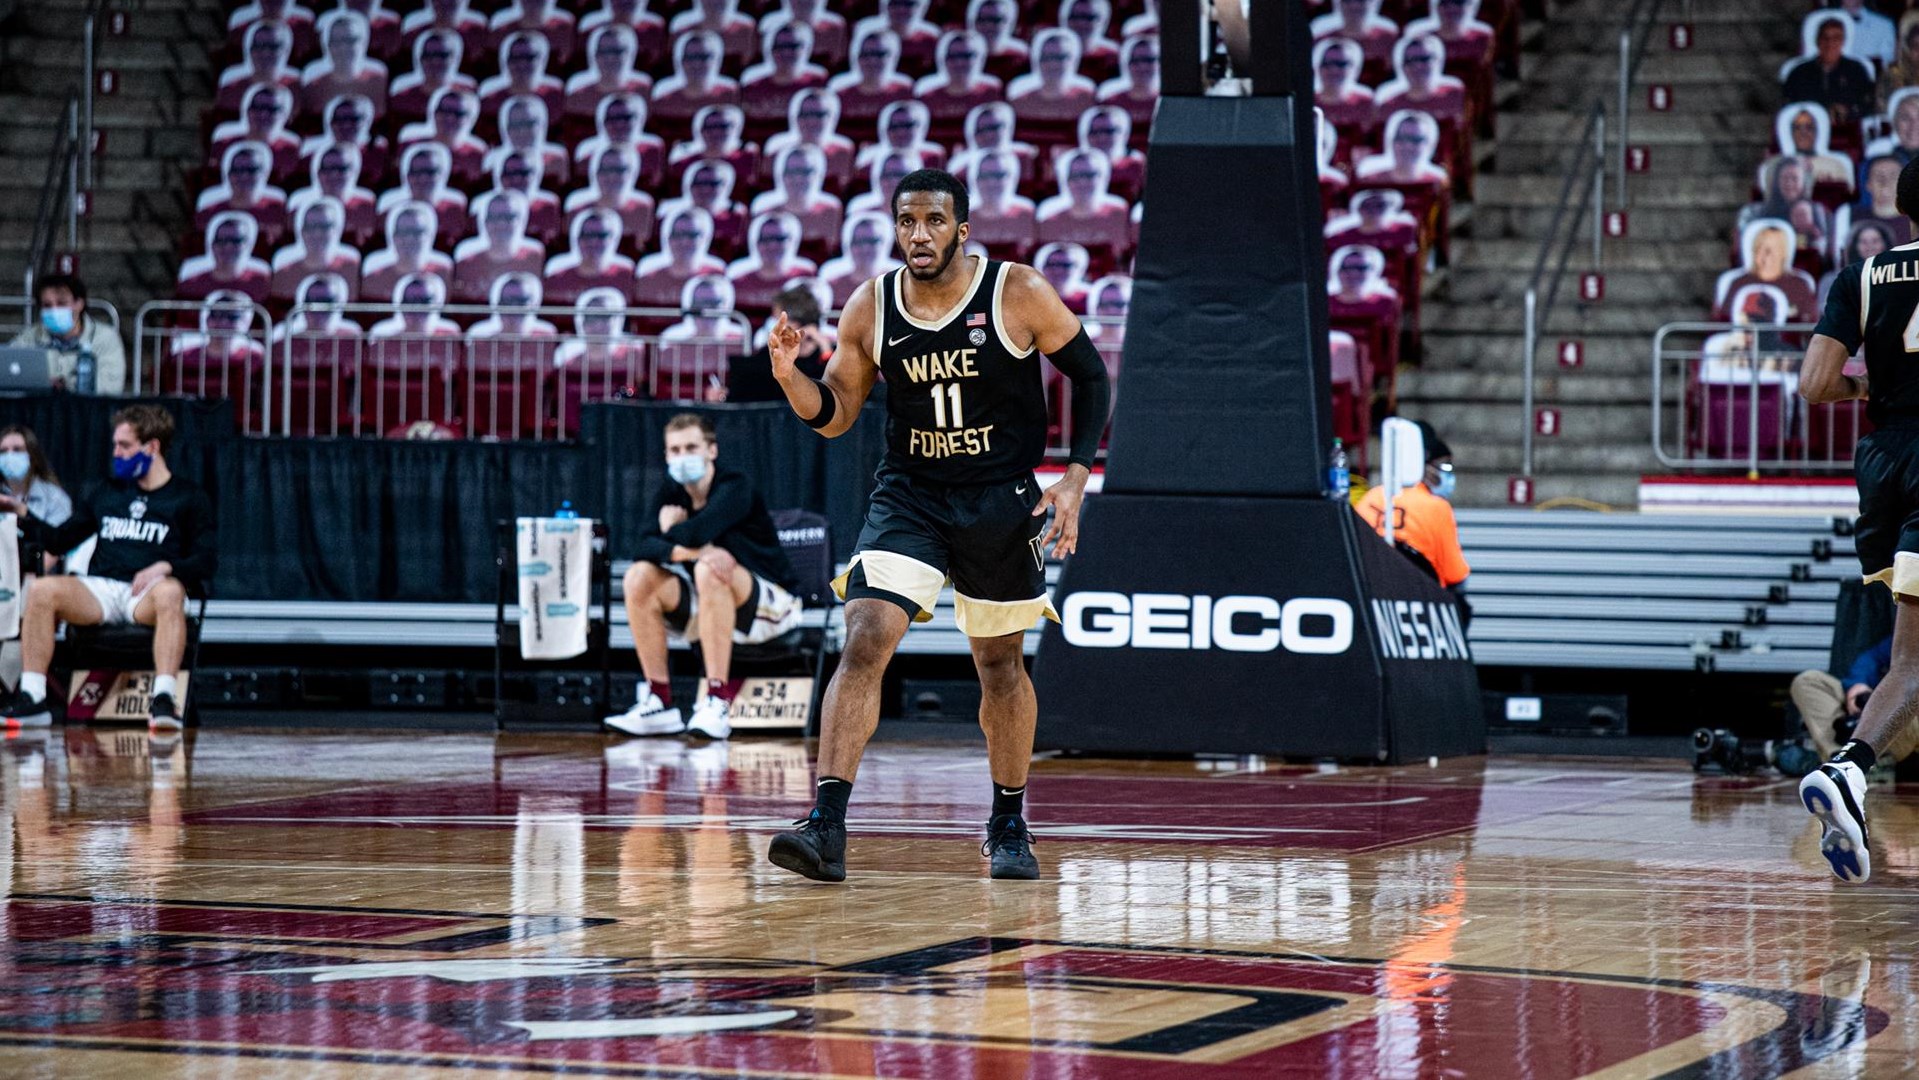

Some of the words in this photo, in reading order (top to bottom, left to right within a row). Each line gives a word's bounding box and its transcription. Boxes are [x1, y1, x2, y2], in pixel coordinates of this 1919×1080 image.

[902, 348, 979, 383] WAKE
[930, 382, 964, 429] 11
[909, 424, 994, 459] FOREST
[101, 515, 170, 545] EQUALITY
[1062, 591, 1354, 654] GEICO
[1371, 597, 1469, 661] NISSAN
